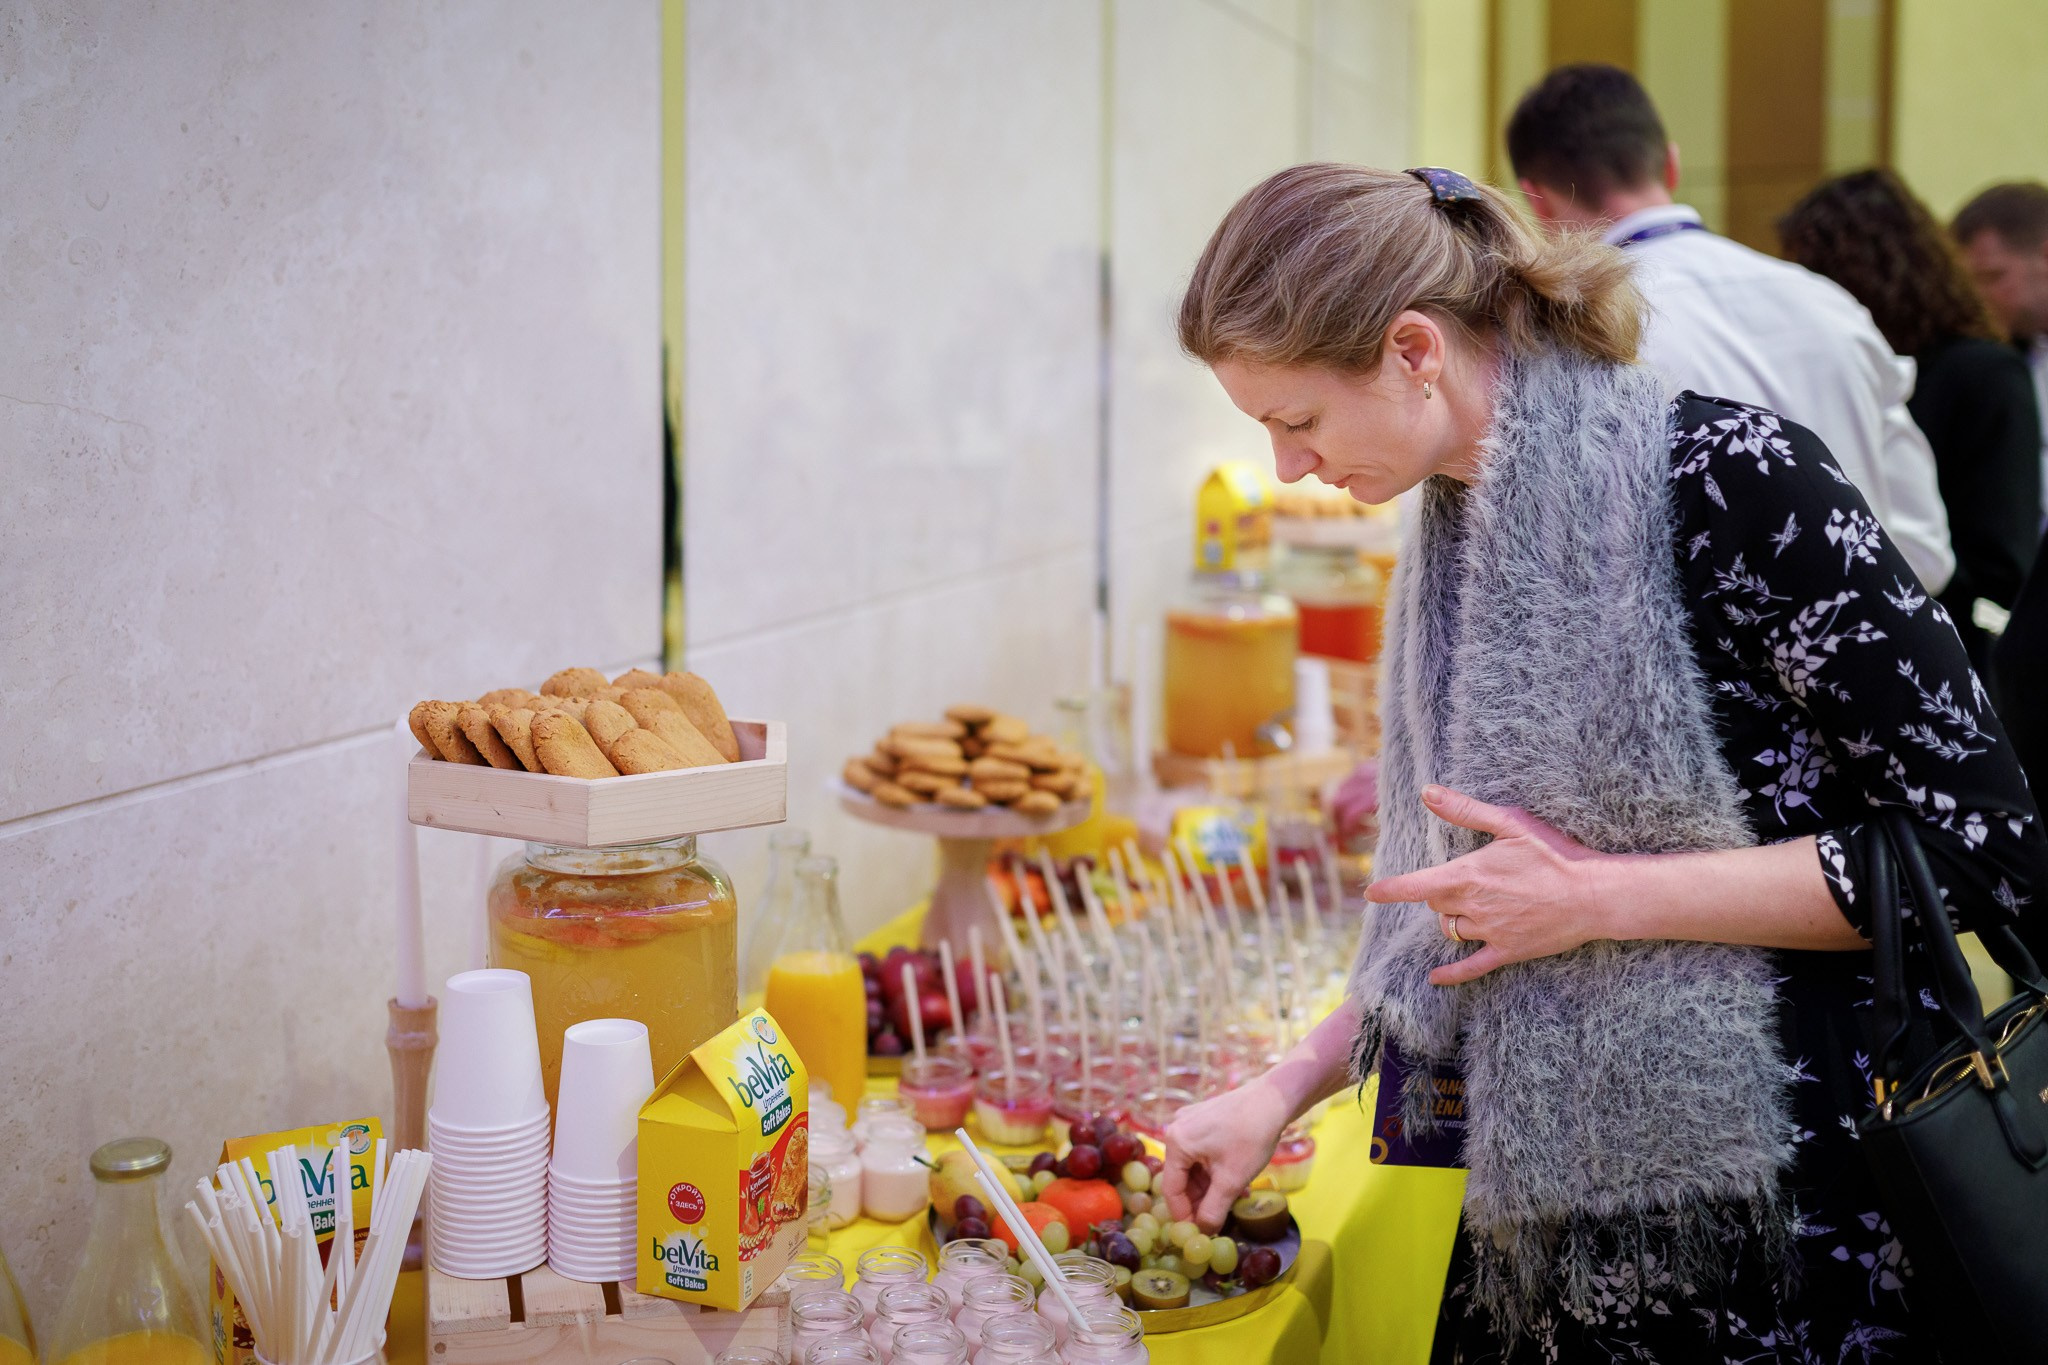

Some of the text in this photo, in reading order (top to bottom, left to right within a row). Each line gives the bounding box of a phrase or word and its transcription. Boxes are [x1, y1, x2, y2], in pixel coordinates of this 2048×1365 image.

[728, 1041, 795, 1108] belVita
[763, 1113, 776, 1133] Soft
[775, 1104, 791, 1125] Bakes
[255, 1149, 370, 1205] blVia
[670, 1184, 704, 1204] ОТКРОЙТЕ
[675, 1200, 698, 1210] ЗДЕСЬ
[314, 1212, 335, 1230] Bak
[653, 1236, 720, 1272] belVita
[668, 1275, 706, 1290] Soft Bakes
